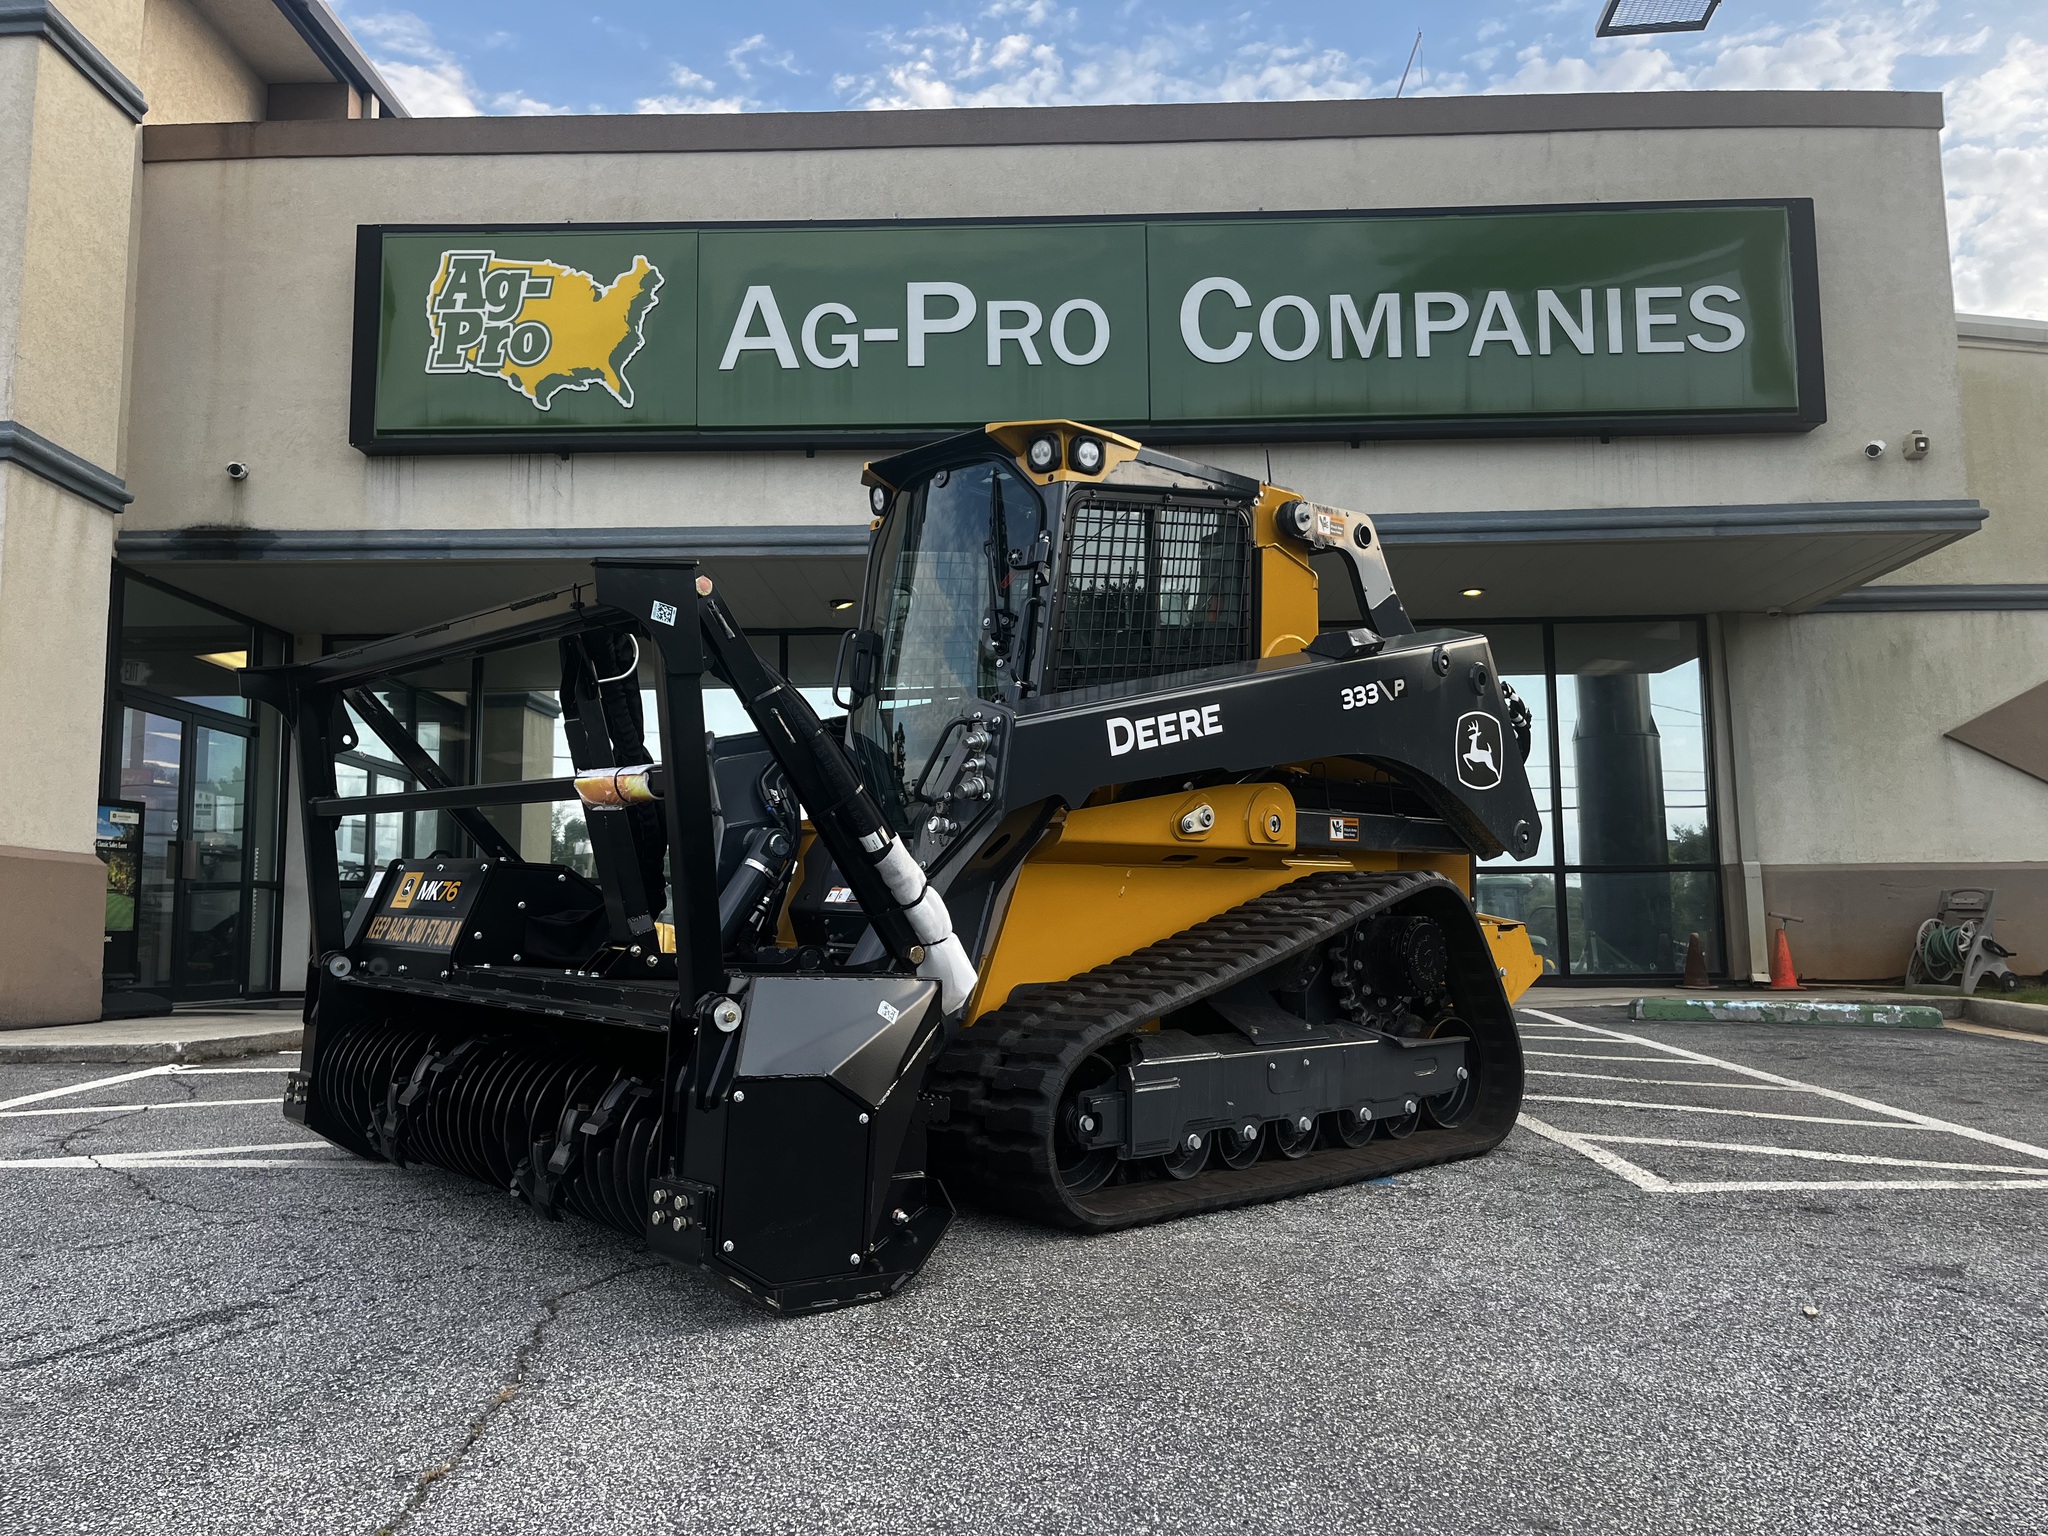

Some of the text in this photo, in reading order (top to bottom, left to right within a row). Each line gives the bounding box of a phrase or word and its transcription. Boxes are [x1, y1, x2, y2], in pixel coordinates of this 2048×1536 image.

[432, 252, 555, 324] Ag-
[429, 310, 553, 368] Pro
[1179, 276, 1746, 363] COMPANIES
[1106, 703, 1224, 757] DEERE
[416, 880, 462, 902] MK76
[366, 916, 392, 940] KEEP
[385, 917, 414, 942] BACK
[407, 918, 429, 944] 300
